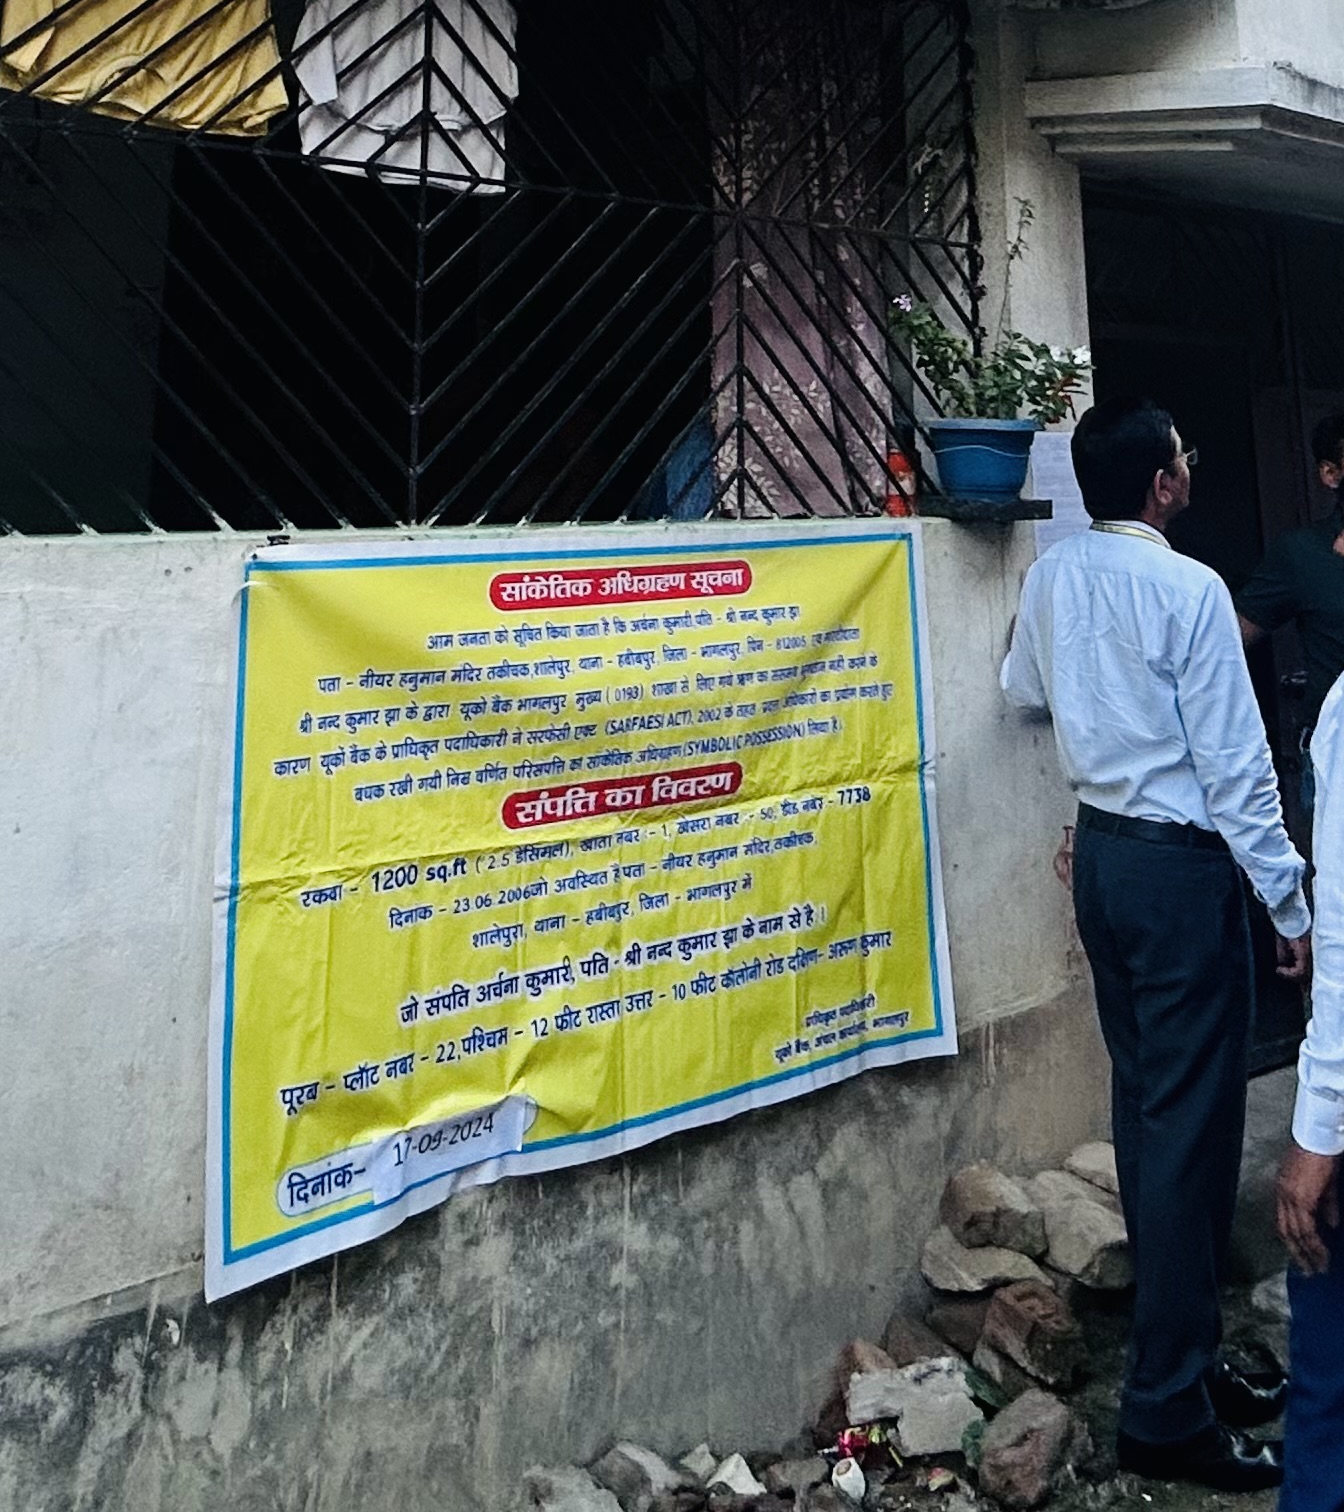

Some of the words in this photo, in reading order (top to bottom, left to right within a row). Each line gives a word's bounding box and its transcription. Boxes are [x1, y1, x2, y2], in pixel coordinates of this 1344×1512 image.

[499, 574, 593, 602] सांकेतिक
[597, 570, 687, 596] अधिग्रहण
[689, 568, 744, 594] सूचना
[427, 634, 454, 650] आम
[457, 631, 490, 647] जनता
[494, 628, 509, 644] को
[317, 676, 342, 693] पता
[399, 670, 446, 693] हनुमान
[299, 712, 313, 733] श्री
[344, 709, 381, 735] कुमार
[384, 707, 401, 727] झा
[405, 700, 420, 720] के
[422, 704, 451, 722] द्वारा
[517, 694, 568, 716] भागलपुर
[273, 756, 312, 776] कारण
[374, 740, 388, 761] के
[444, 727, 509, 752] पदाधिकारी
[512, 726, 523, 745] ने
[515, 786, 599, 824] संपत्ति
[604, 785, 646, 807] का
[651, 772, 734, 802] विवरण
[696, 845, 738, 869] हनुमान
[371, 863, 419, 892] 1200
[638, 892, 669, 910] जिला
[686, 880, 738, 902] भागलपुर
[400, 995, 419, 1023] जो
[476, 971, 519, 1003] अर्चना
[579, 951, 609, 977] पति
[624, 942, 642, 966] श्री
[646, 940, 673, 960] नन्द
[676, 931, 718, 962] कुमार
[721, 927, 738, 950] झा
[741, 917, 756, 939] के
[758, 915, 784, 935] नाम
[787, 907, 802, 929] से
[279, 1081, 320, 1116] पूरब
[531, 1017, 549, 1037] 12
[554, 1004, 582, 1032] फीट
[585, 999, 621, 1024] रास्ता
[624, 989, 654, 1013] उत्तर
[671, 983, 686, 1001] 10
[690, 970, 717, 996] फीट
[859, 930, 892, 958] कुमार
[393, 1112, 495, 1168] 17-09-2024
